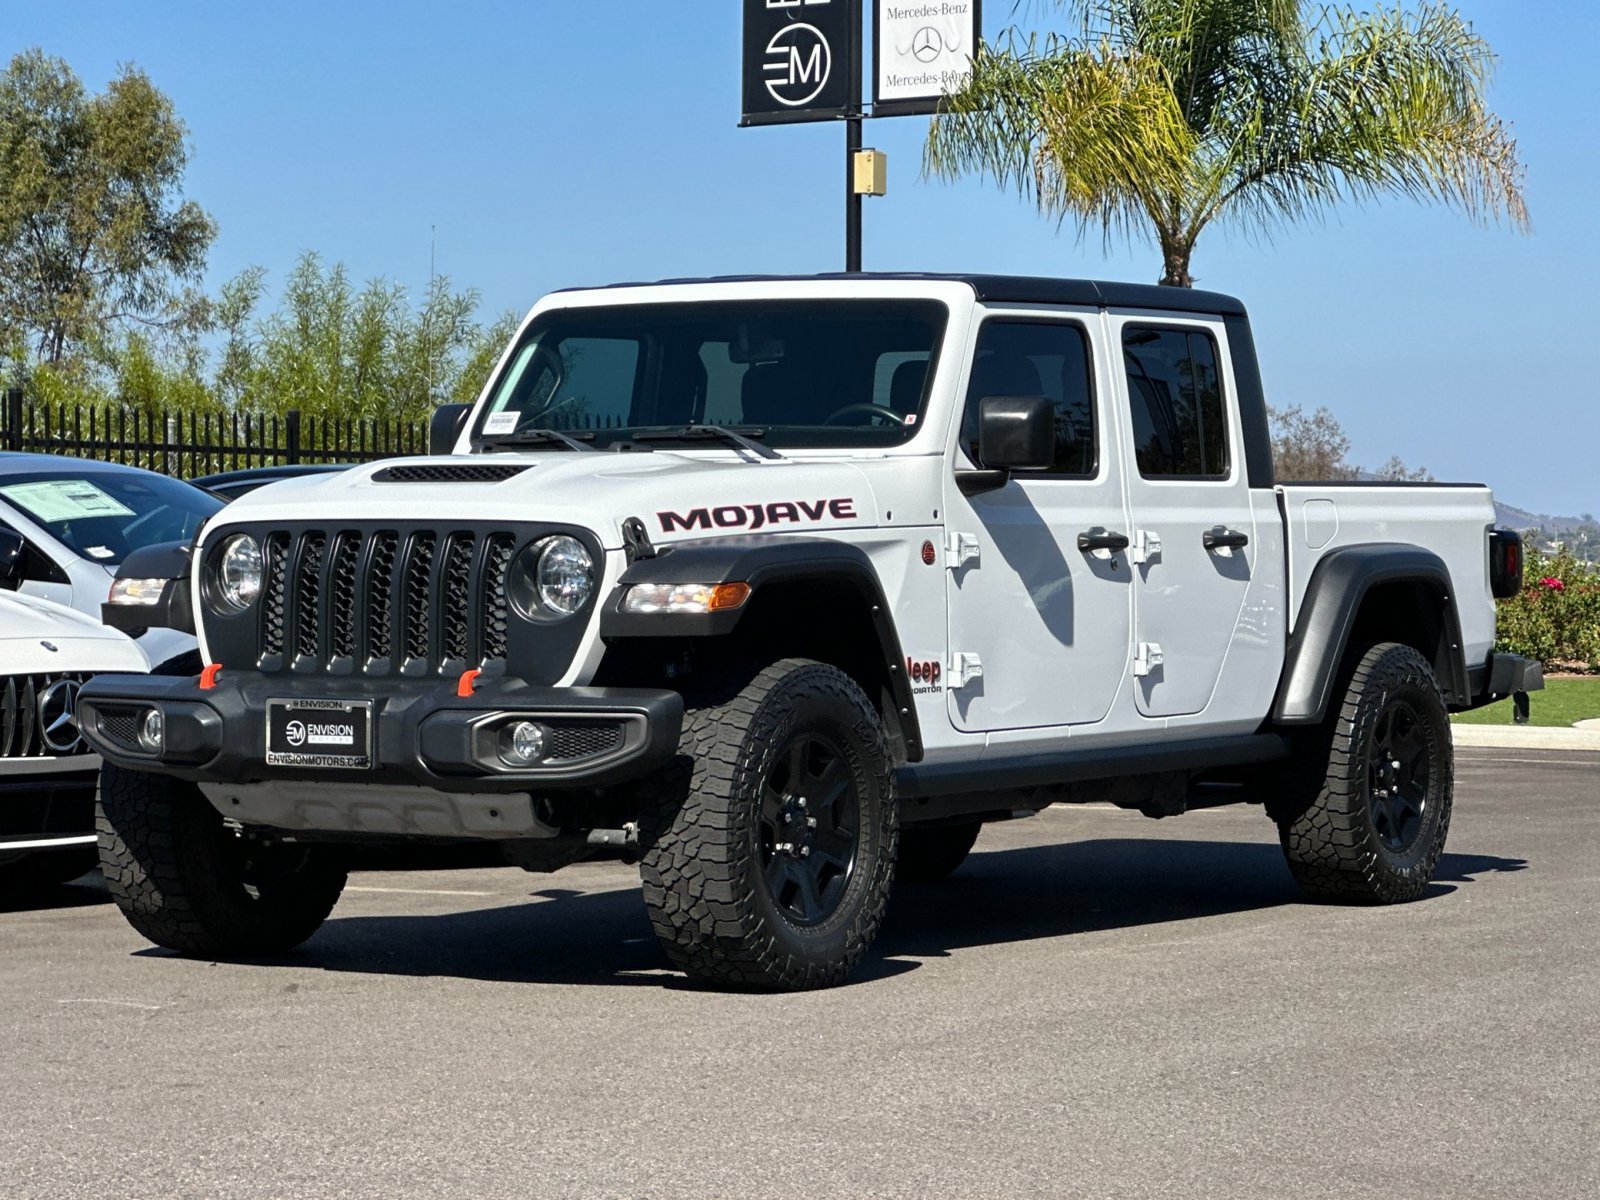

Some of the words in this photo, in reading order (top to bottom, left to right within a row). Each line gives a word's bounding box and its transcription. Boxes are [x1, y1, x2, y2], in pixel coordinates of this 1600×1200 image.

[887, 3, 967, 20] Mercedes-Benz
[886, 70, 962, 87] Mercedes-Ben
[656, 498, 857, 532] MOJAVE
[912, 686, 942, 694] DIATOR
[300, 700, 342, 709] ENVISION
[308, 724, 353, 736] ENVISION
